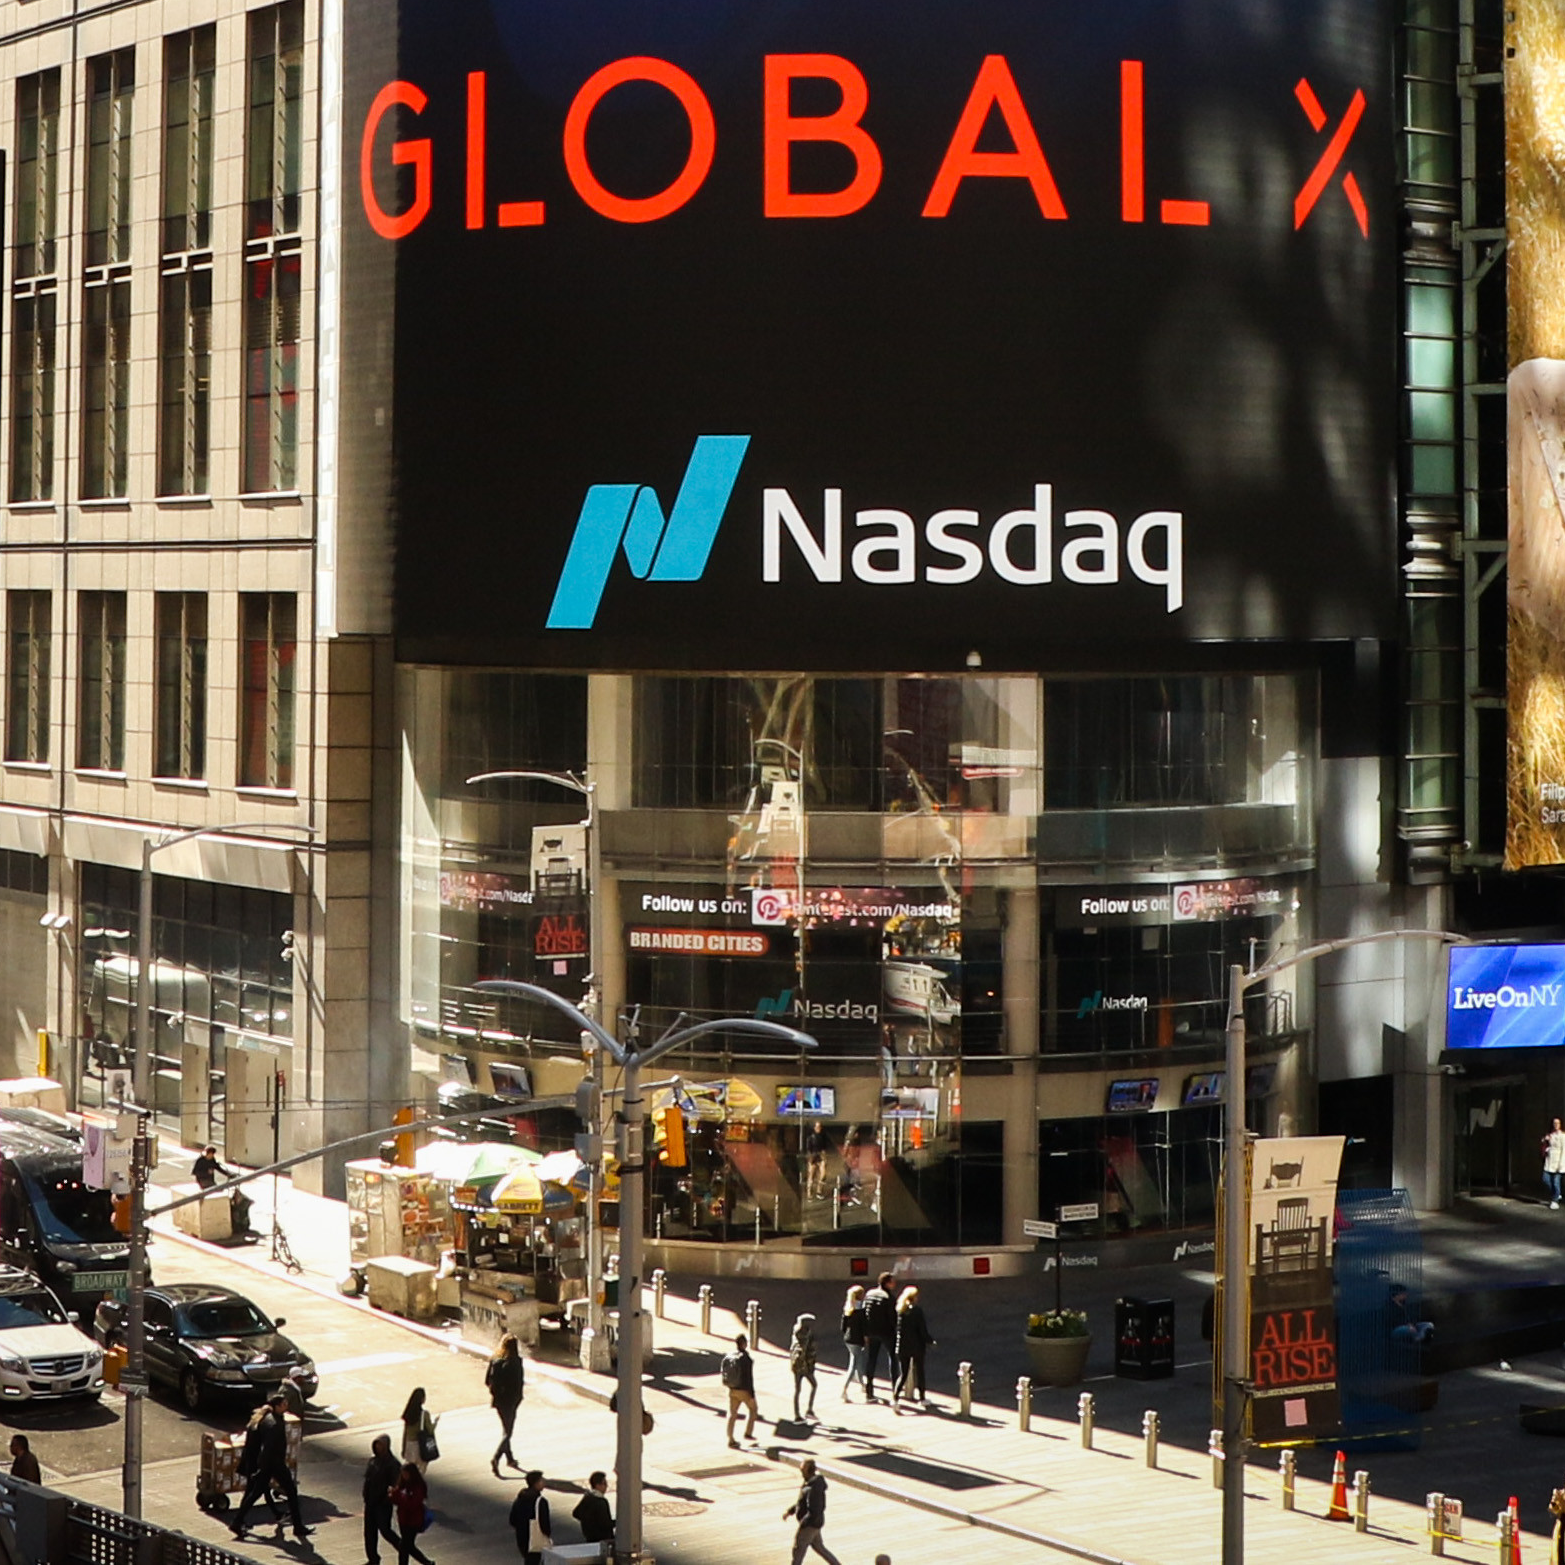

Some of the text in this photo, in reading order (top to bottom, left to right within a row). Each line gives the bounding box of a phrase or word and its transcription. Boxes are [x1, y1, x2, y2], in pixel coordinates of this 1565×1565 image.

[360, 53, 1370, 241] GLOBAL X
[762, 482, 1184, 615] Nasdaq
[642, 894, 694, 913] Follow
[699, 898, 717, 914] us
[721, 899, 747, 915] on:
[1081, 898, 1129, 915] Follow
[1132, 899, 1148, 912] us
[538, 916, 582, 935] ALL
[535, 935, 586, 954] RISE
[630, 932, 763, 952] BRANDED CITIES
[1102, 994, 1148, 1012] Nasdaq
[1453, 984, 1562, 1010] LiveOnNY
[794, 999, 878, 1024] Nasdaq
[1061, 1255, 1098, 1266] Nasdaq
[74, 1274, 124, 1290] BROADWAY
[1258, 1309, 1327, 1350] ALL
[1254, 1343, 1336, 1384] RISE
